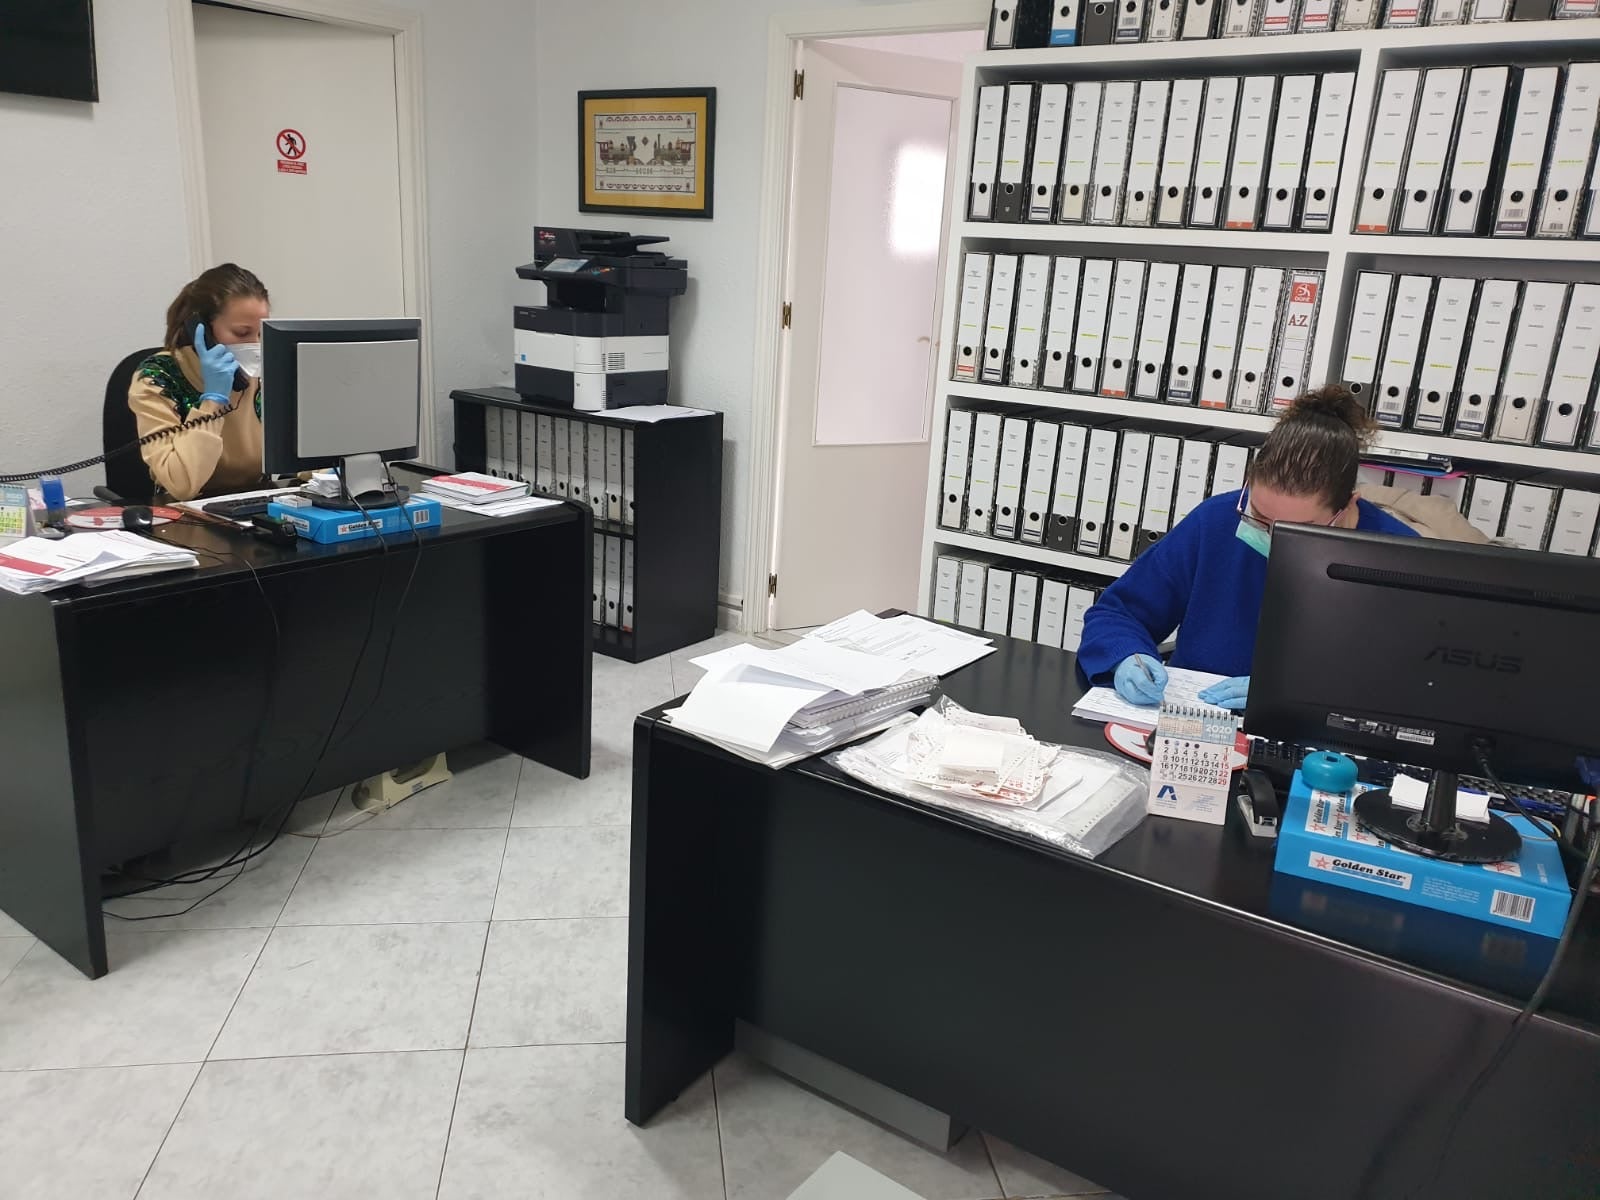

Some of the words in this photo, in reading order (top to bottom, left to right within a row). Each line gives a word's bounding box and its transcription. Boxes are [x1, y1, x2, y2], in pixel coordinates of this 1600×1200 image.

[1288, 313, 1308, 328] A-Z
[1424, 646, 1523, 673] ASUS
[1206, 724, 1233, 734] 2020
[1171, 755, 1180, 763] 10
[1218, 770, 1228, 778] 22
[1217, 778, 1227, 786] 29
[1332, 859, 1374, 875] Golden
[1375, 865, 1404, 881] Star
